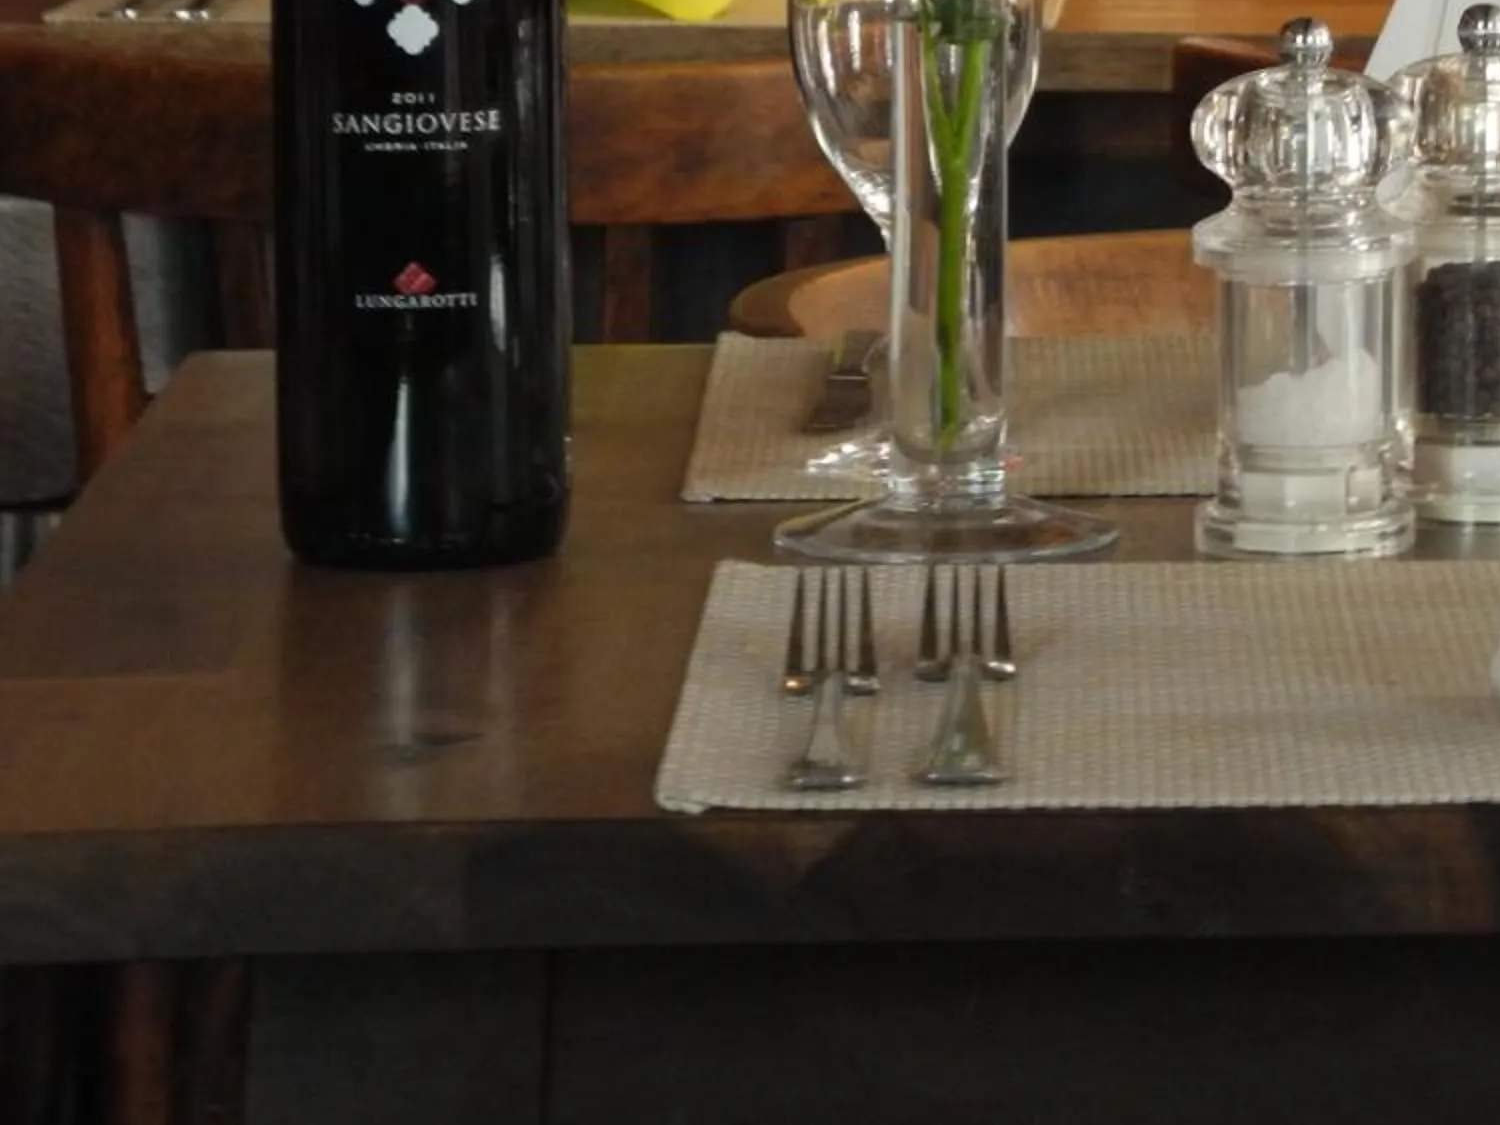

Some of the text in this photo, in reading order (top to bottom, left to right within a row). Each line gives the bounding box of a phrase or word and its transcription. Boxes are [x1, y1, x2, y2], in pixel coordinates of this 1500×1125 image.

[392, 92, 435, 104] 2011
[332, 109, 500, 135] SANGIOVESE
[356, 293, 478, 308] LUNGAROTTI
